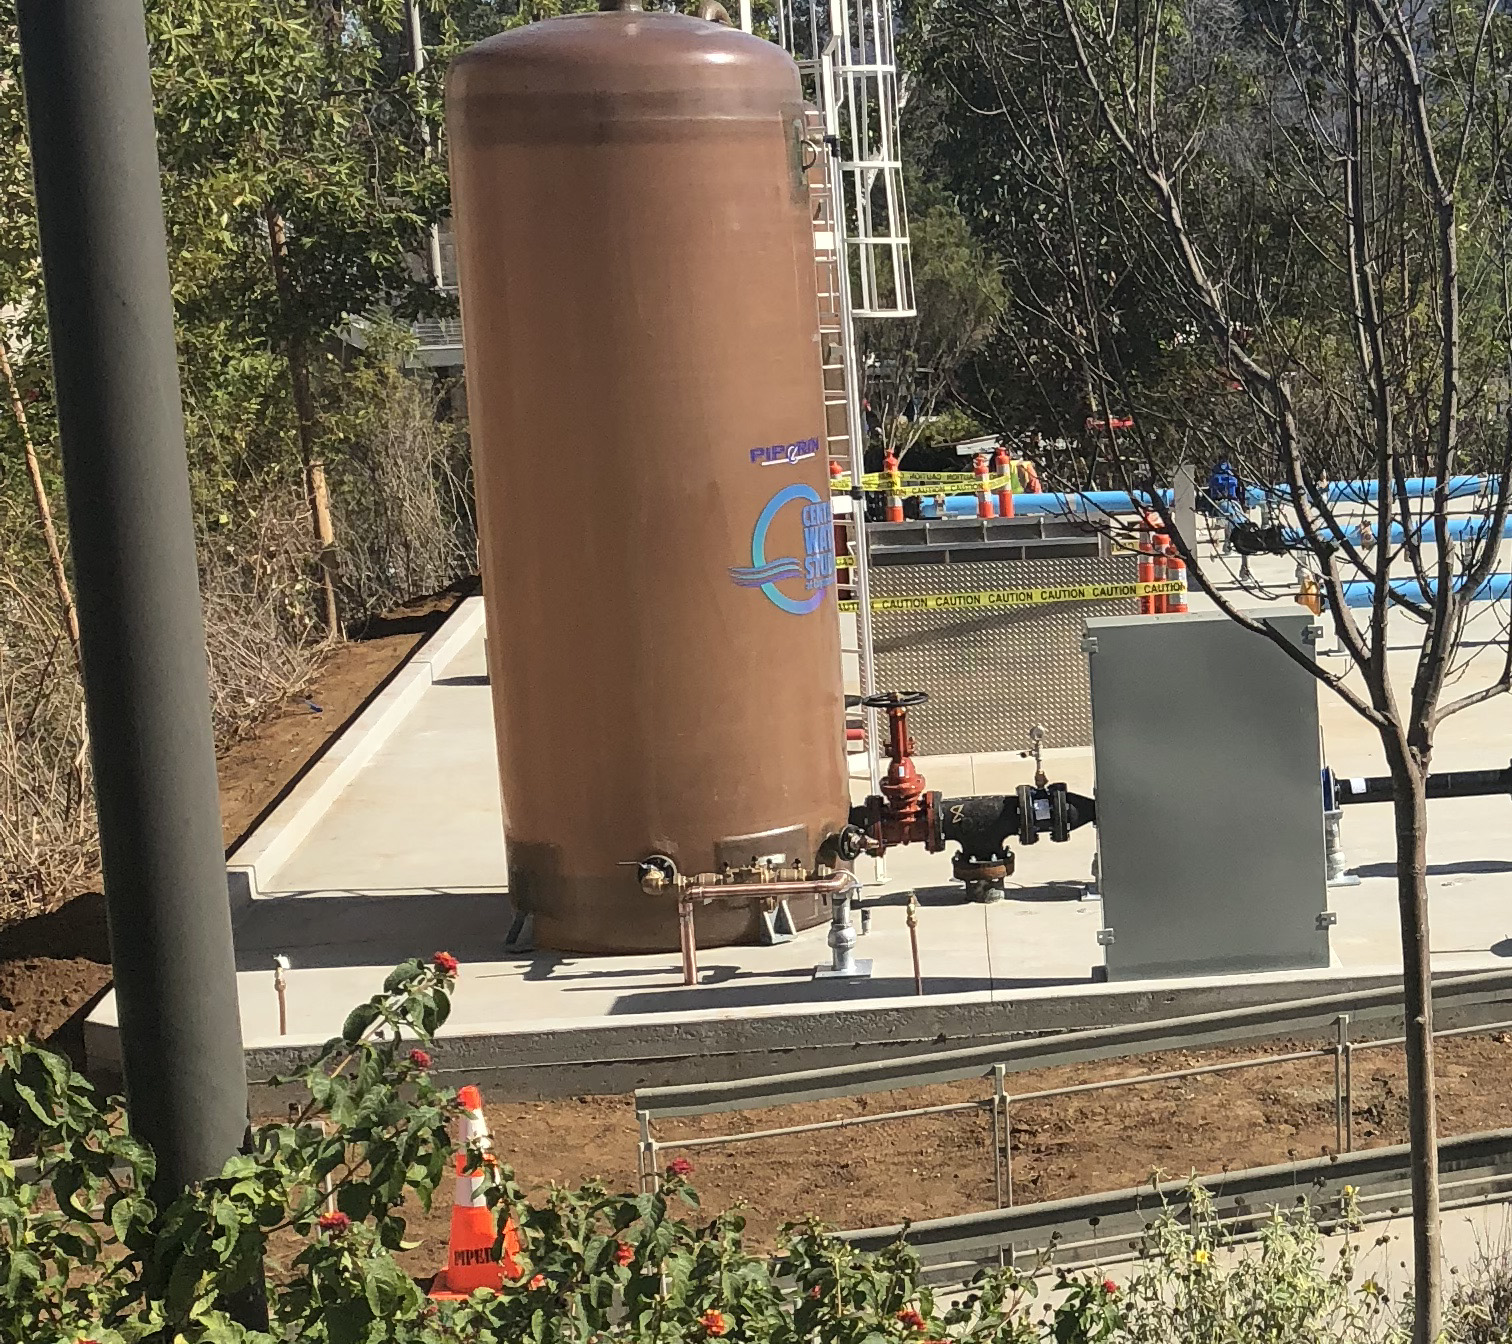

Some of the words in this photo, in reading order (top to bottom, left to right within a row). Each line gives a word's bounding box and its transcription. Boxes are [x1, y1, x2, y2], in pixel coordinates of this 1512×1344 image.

[951, 483, 983, 492] CAUTION
[882, 597, 928, 609] CAUTION
[935, 594, 981, 606] CAUTION
[988, 591, 1033, 603] CAUTION
[1040, 588, 1085, 600] CAUTION
[1092, 585, 1137, 597] CAUTION
[1143, 581, 1186, 594] CAUTION
[950, 803, 965, 824] 8
